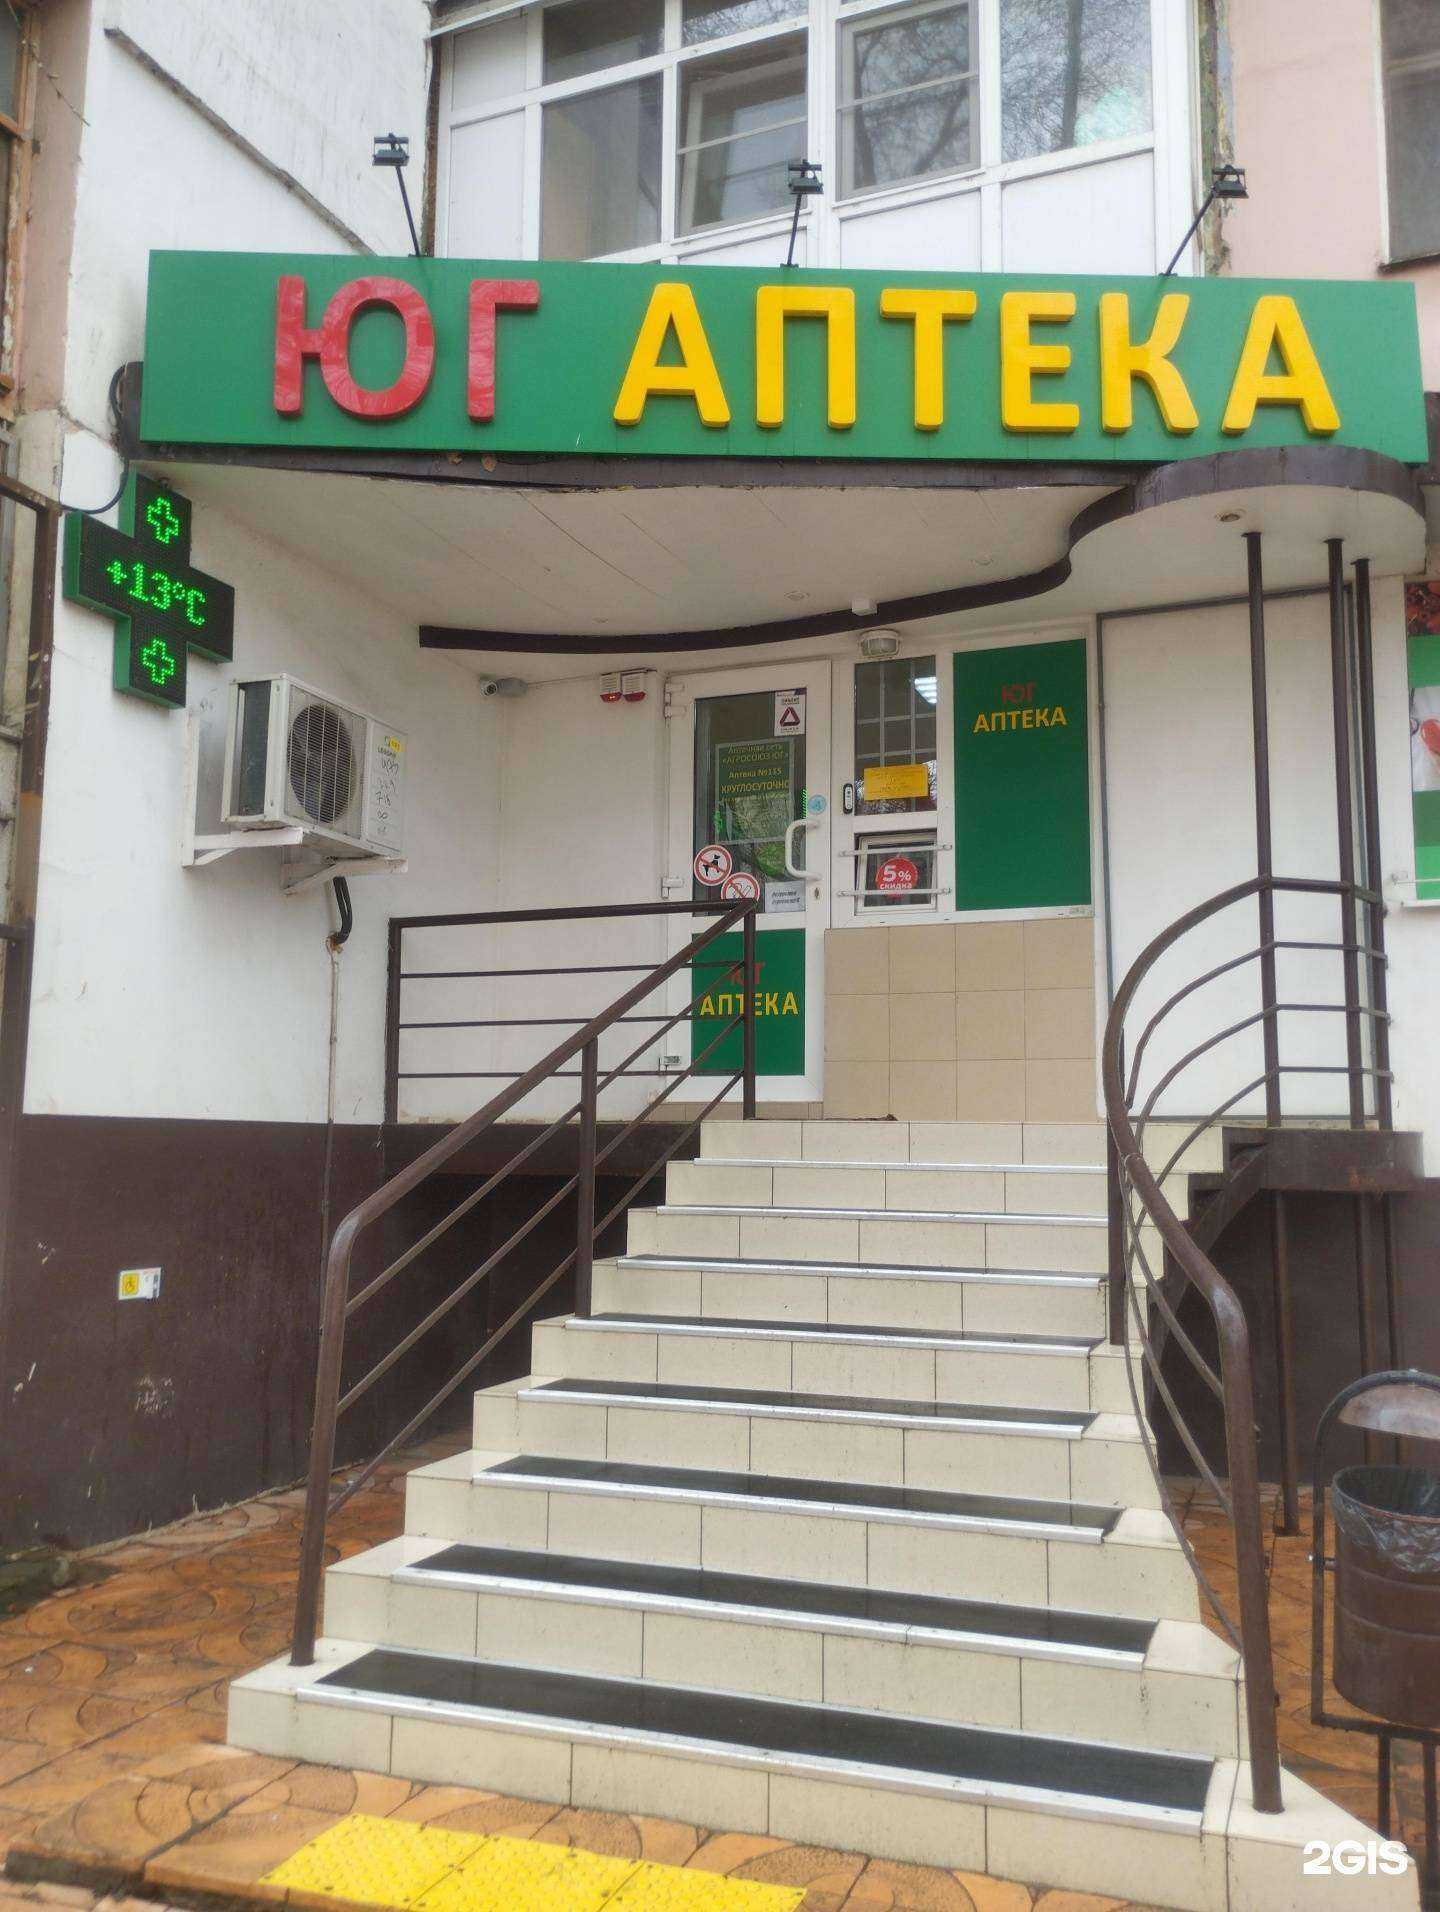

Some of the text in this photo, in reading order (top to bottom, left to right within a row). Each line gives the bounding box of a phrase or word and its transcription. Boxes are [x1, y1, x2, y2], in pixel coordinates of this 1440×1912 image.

[273, 275, 1342, 436] ЮГ АПТЕКА
[1001, 682, 1036, 705] ЮГ
[973, 706, 1068, 733] АПТЕКА
